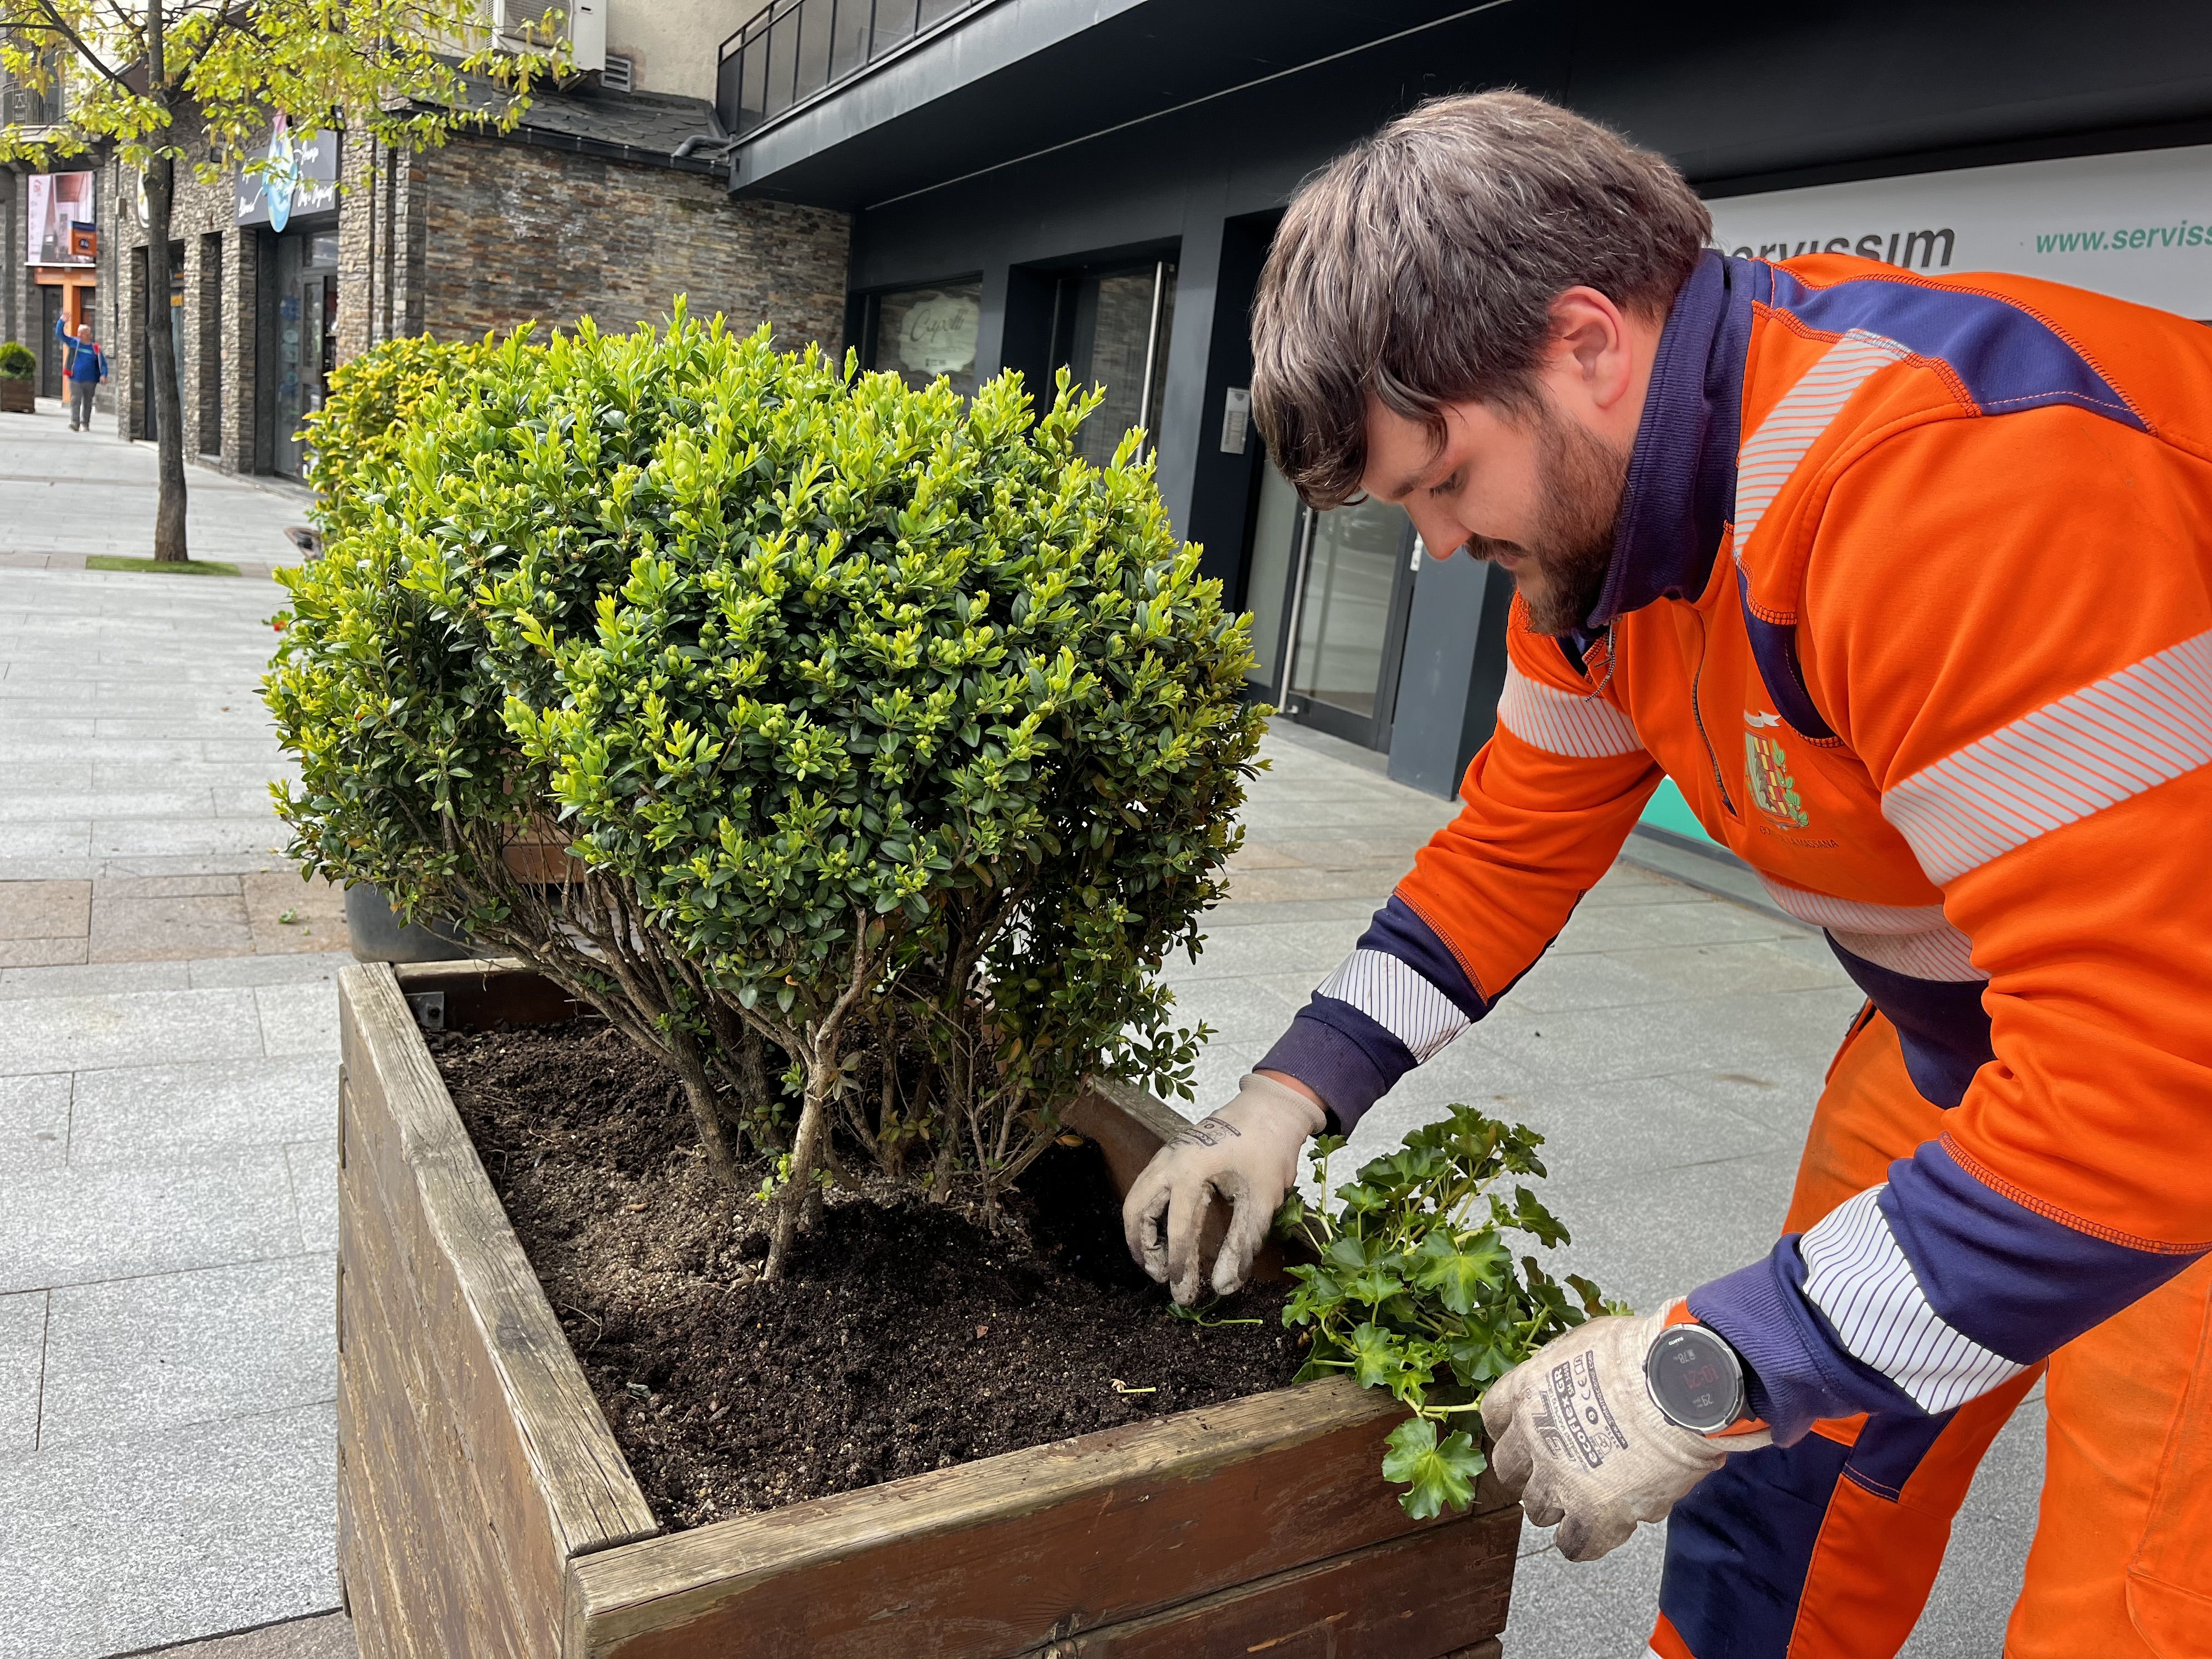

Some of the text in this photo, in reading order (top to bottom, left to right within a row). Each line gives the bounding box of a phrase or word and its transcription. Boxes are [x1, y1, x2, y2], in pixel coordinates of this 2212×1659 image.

[2036, 220, 2212, 253] www.servis
[1668, 1336, 1684, 1346] SUUNTO
[1554, 1368, 1597, 1464] ecoflex GR
